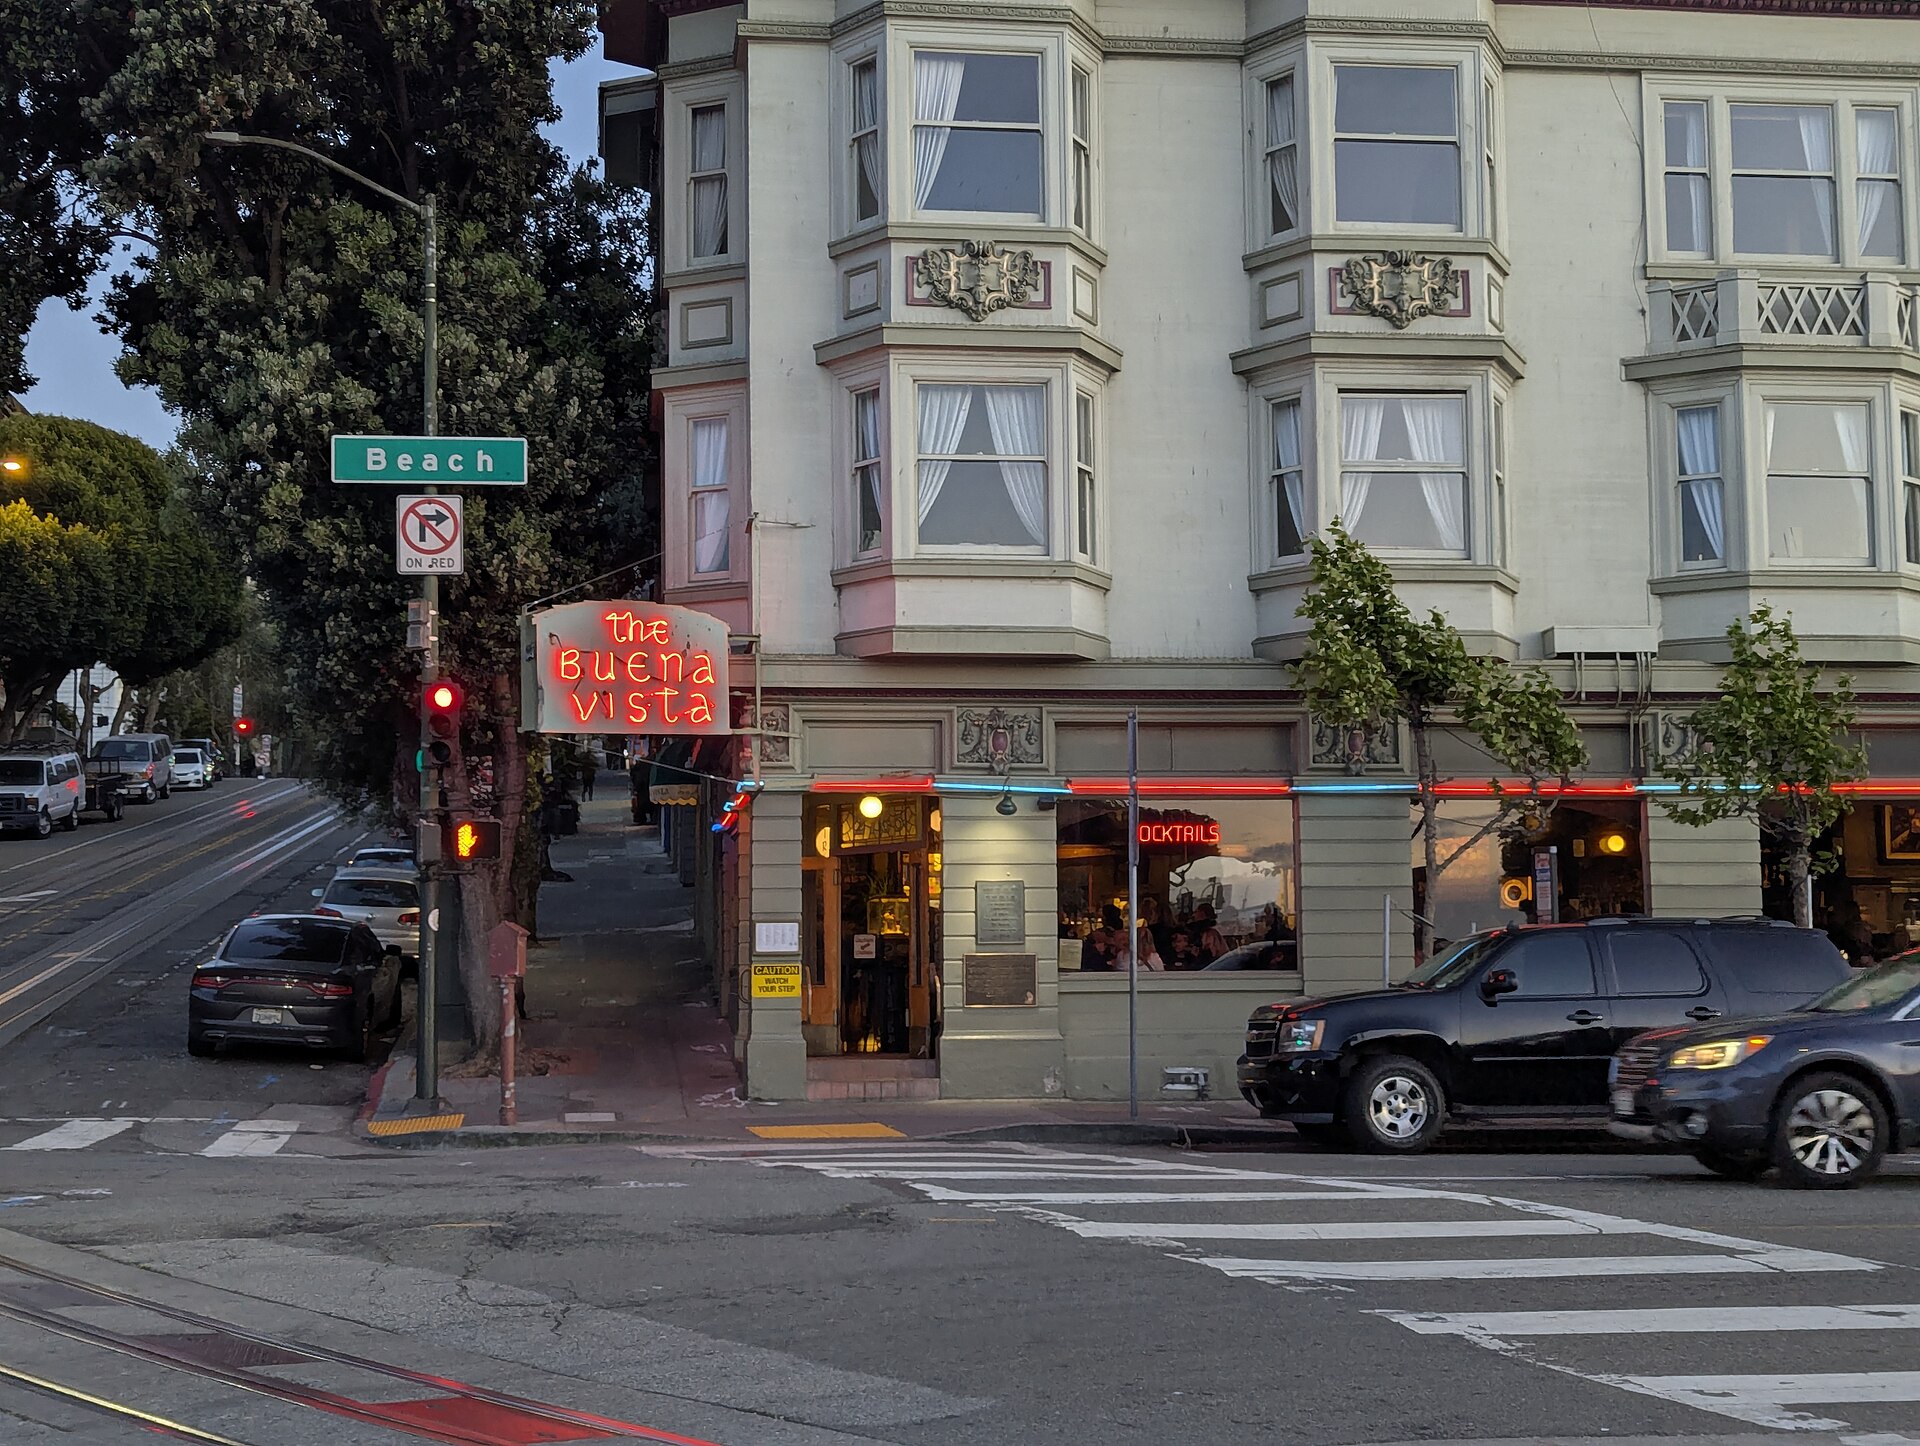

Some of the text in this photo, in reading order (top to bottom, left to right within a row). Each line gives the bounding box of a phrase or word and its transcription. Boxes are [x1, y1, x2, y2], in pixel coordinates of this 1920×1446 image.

[366, 447, 494, 472] Beach
[405, 557, 455, 569] ON RED
[1139, 825, 1220, 842] OCKTAILS
[755, 966, 798, 975] CAUTION
[758, 985, 777, 993] YOUR
